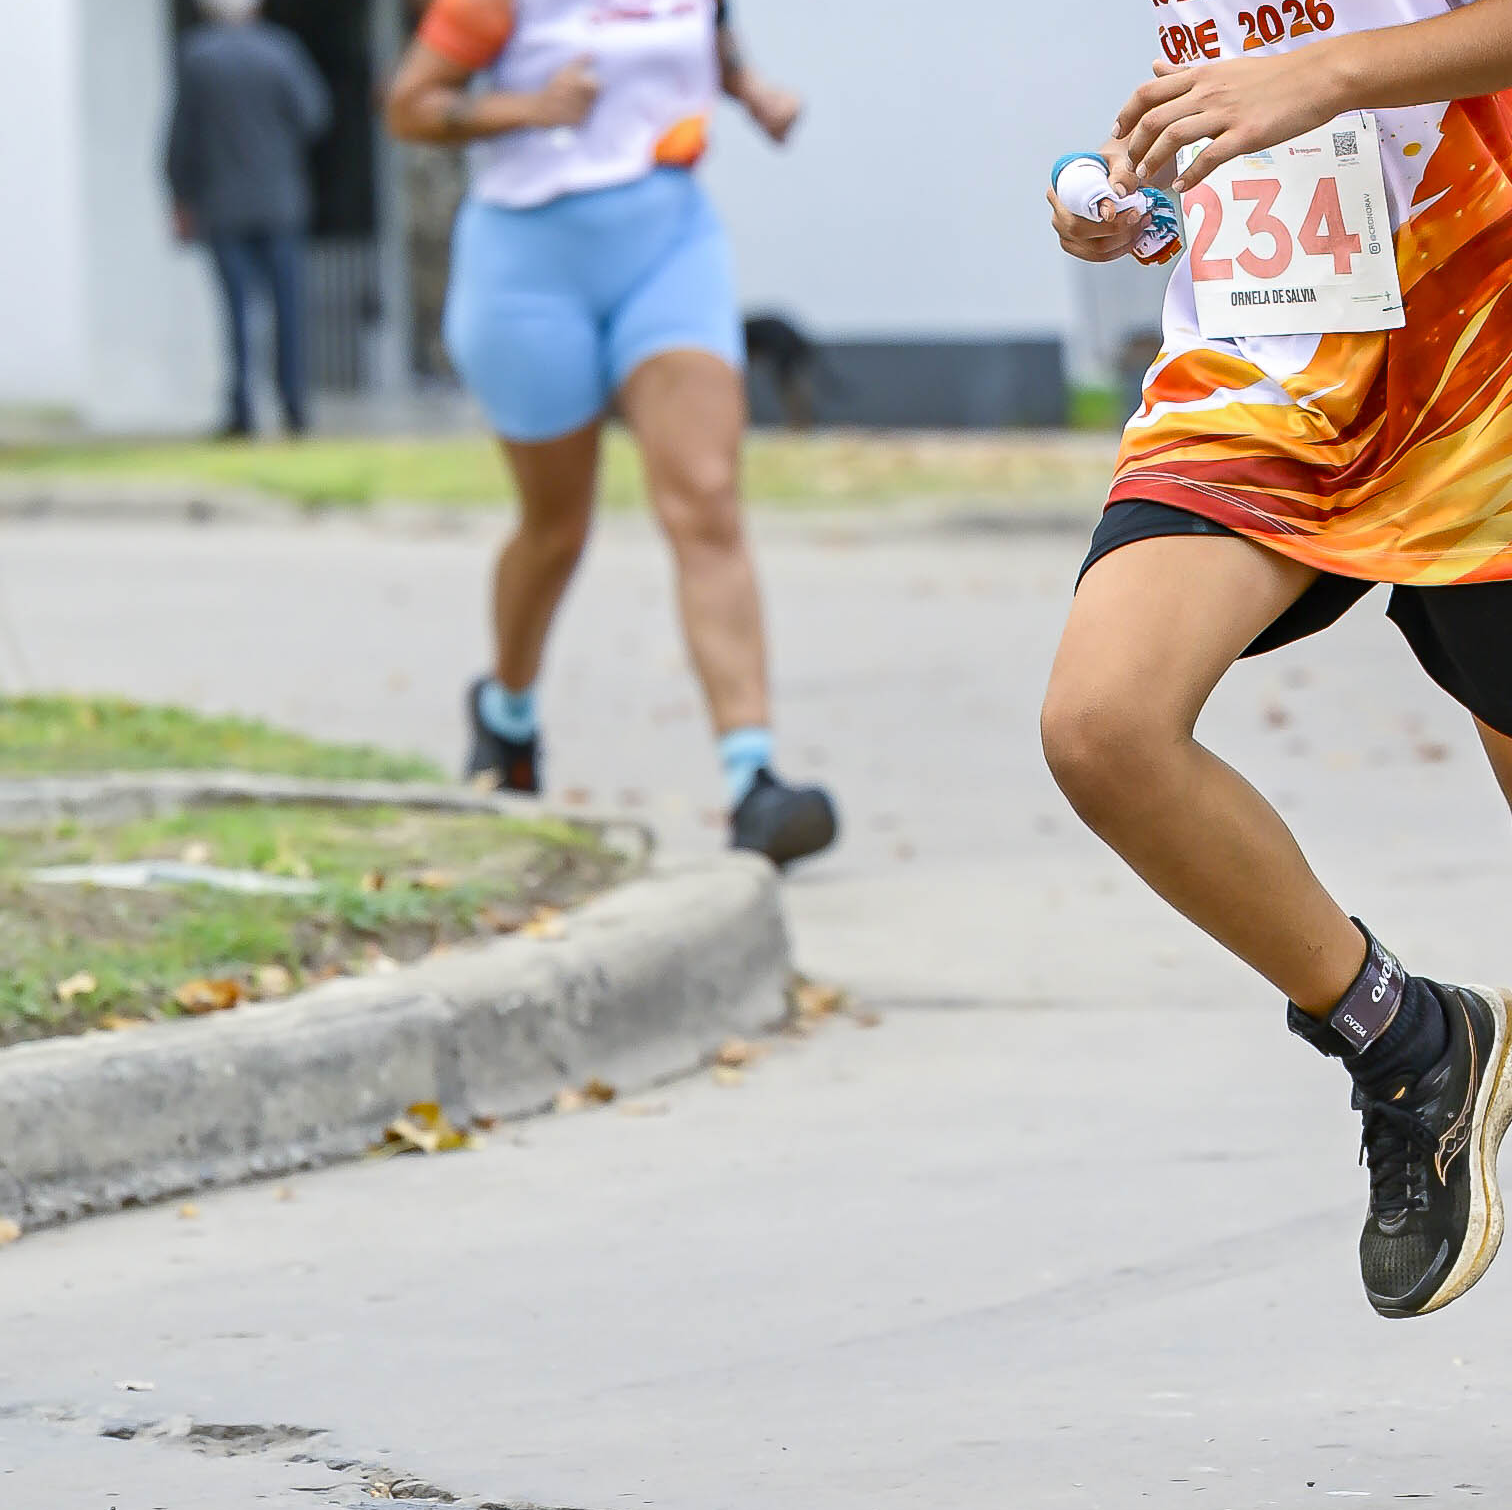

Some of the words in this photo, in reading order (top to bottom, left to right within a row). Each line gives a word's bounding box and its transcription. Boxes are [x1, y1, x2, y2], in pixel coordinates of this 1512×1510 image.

[1182, 177, 1362, 282] 234
[1231, 290, 1271, 306] ORNELA
[1272, 289, 1285, 304] DE
[1286, 288, 1317, 304] SALVIA
[1343, 1014, 1368, 1038] CV234
